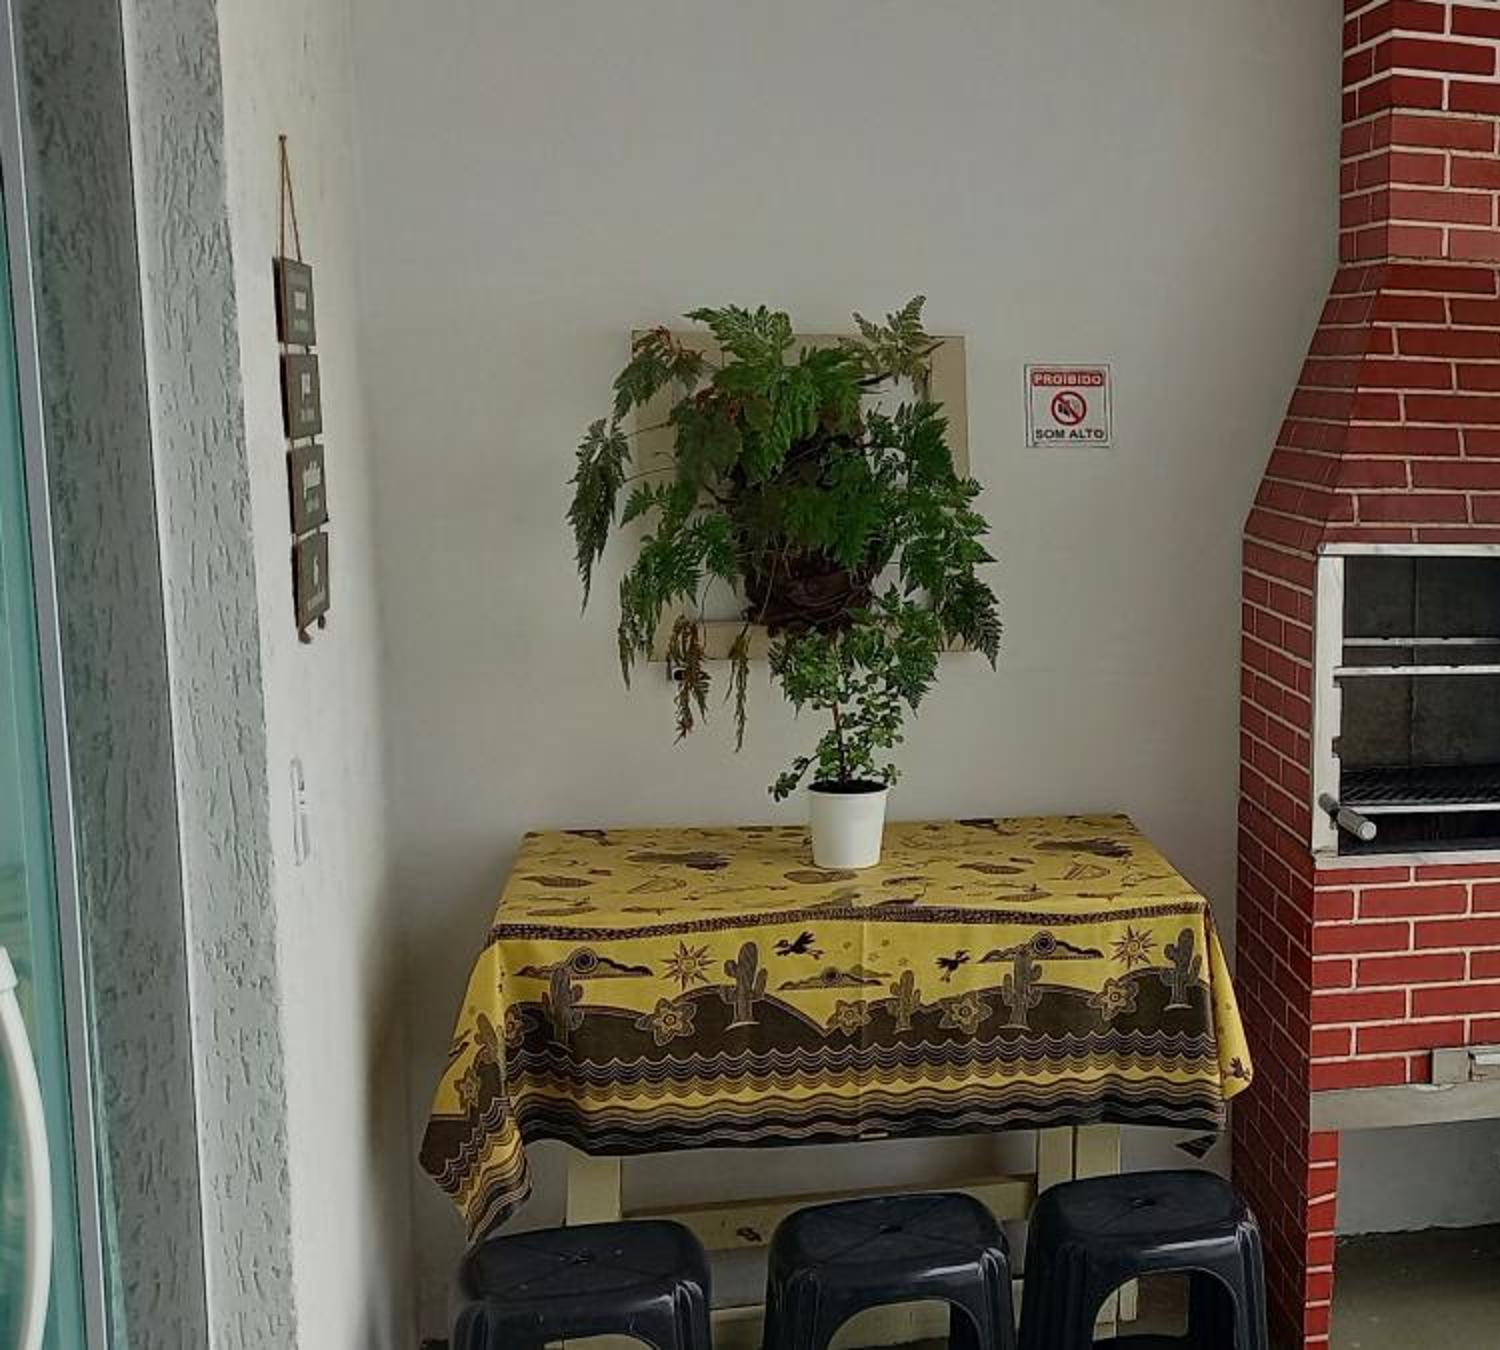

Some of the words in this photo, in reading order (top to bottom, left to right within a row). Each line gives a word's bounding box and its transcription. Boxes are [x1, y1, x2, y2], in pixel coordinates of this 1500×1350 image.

[1034, 373, 1102, 385] PROIBIDO
[1035, 429, 1065, 439] SOM
[1069, 429, 1105, 439] ALTO
